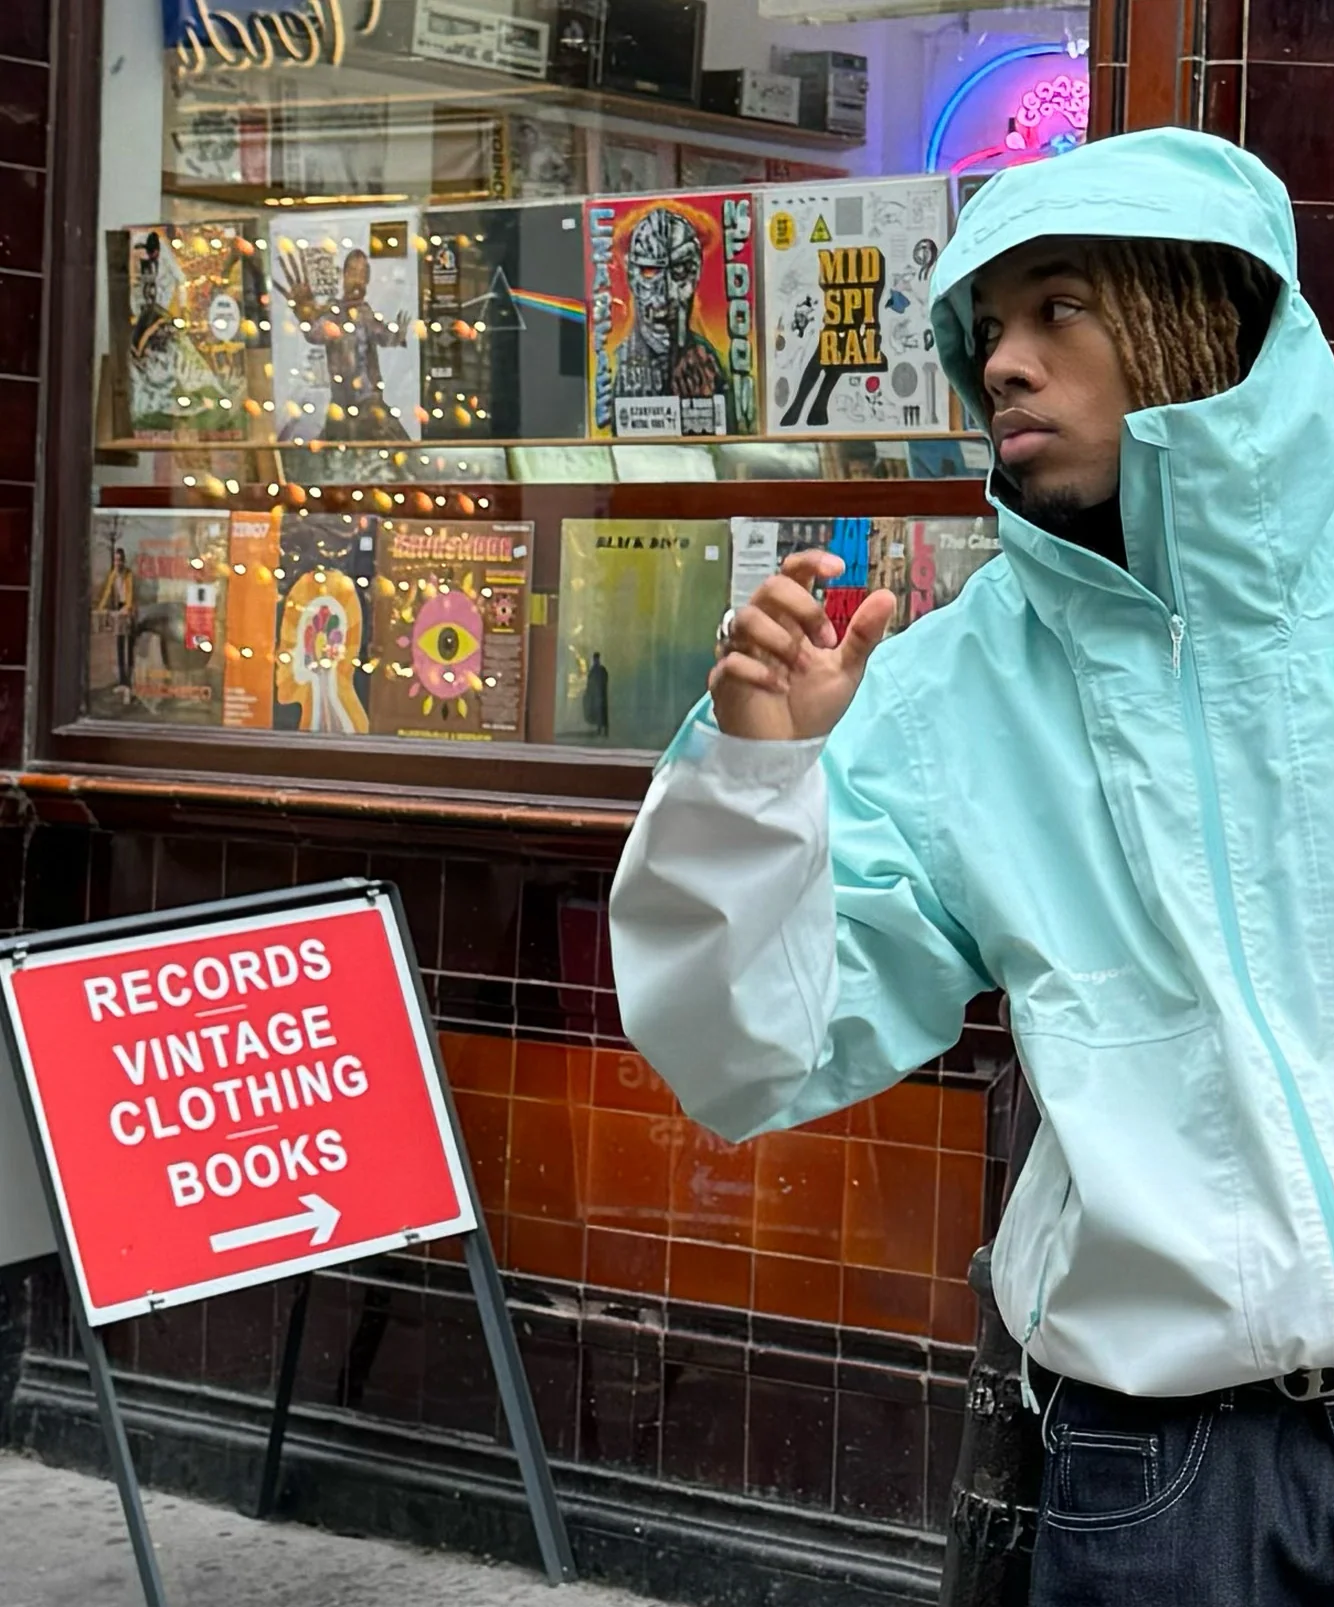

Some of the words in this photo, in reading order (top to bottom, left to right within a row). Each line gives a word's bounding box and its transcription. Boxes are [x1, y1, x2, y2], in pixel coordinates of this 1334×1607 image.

[818, 246, 881, 285] MID
[822, 287, 876, 326] SPI
[819, 328, 883, 366] RAL
[83, 938, 332, 1022] RECORDS
[112, 1005, 337, 1086] VINTAGE
[109, 1054, 369, 1147] CLOTHING
[166, 1129, 348, 1208] BOOKS
